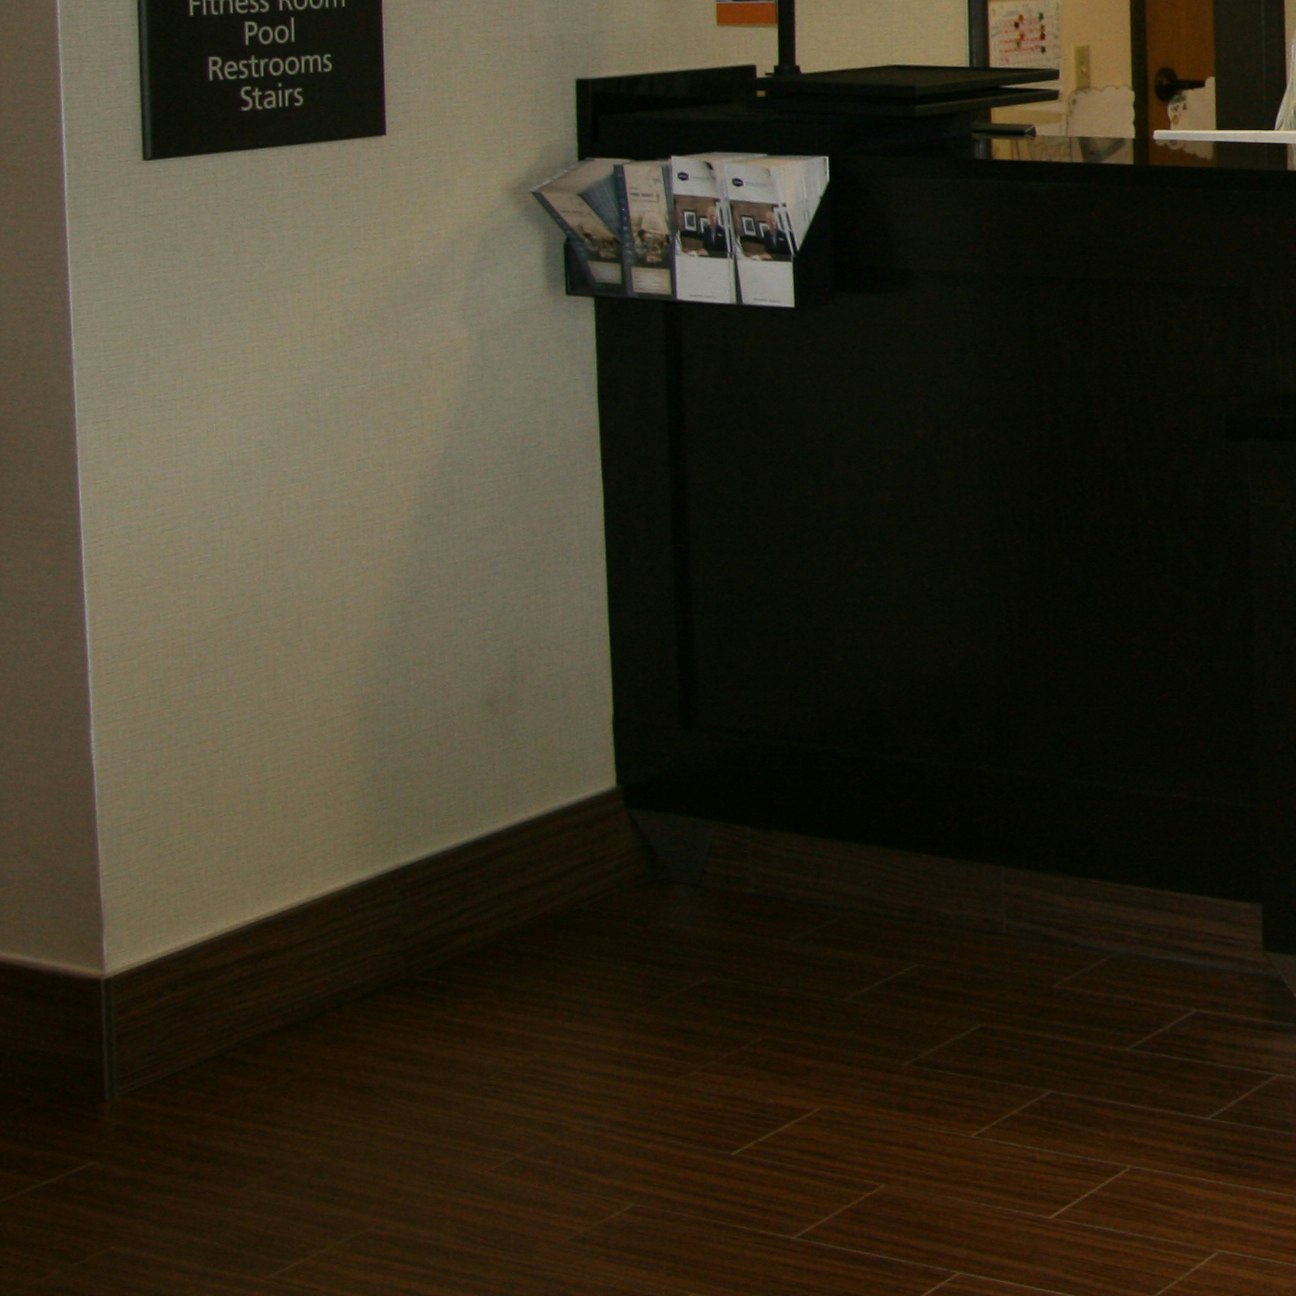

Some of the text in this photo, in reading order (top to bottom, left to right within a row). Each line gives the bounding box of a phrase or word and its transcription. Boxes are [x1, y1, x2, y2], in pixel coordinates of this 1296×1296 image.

[244, 17, 295, 46] Pool
[208, 52, 333, 82] Restrooms
[240, 83, 304, 112] Stairs
